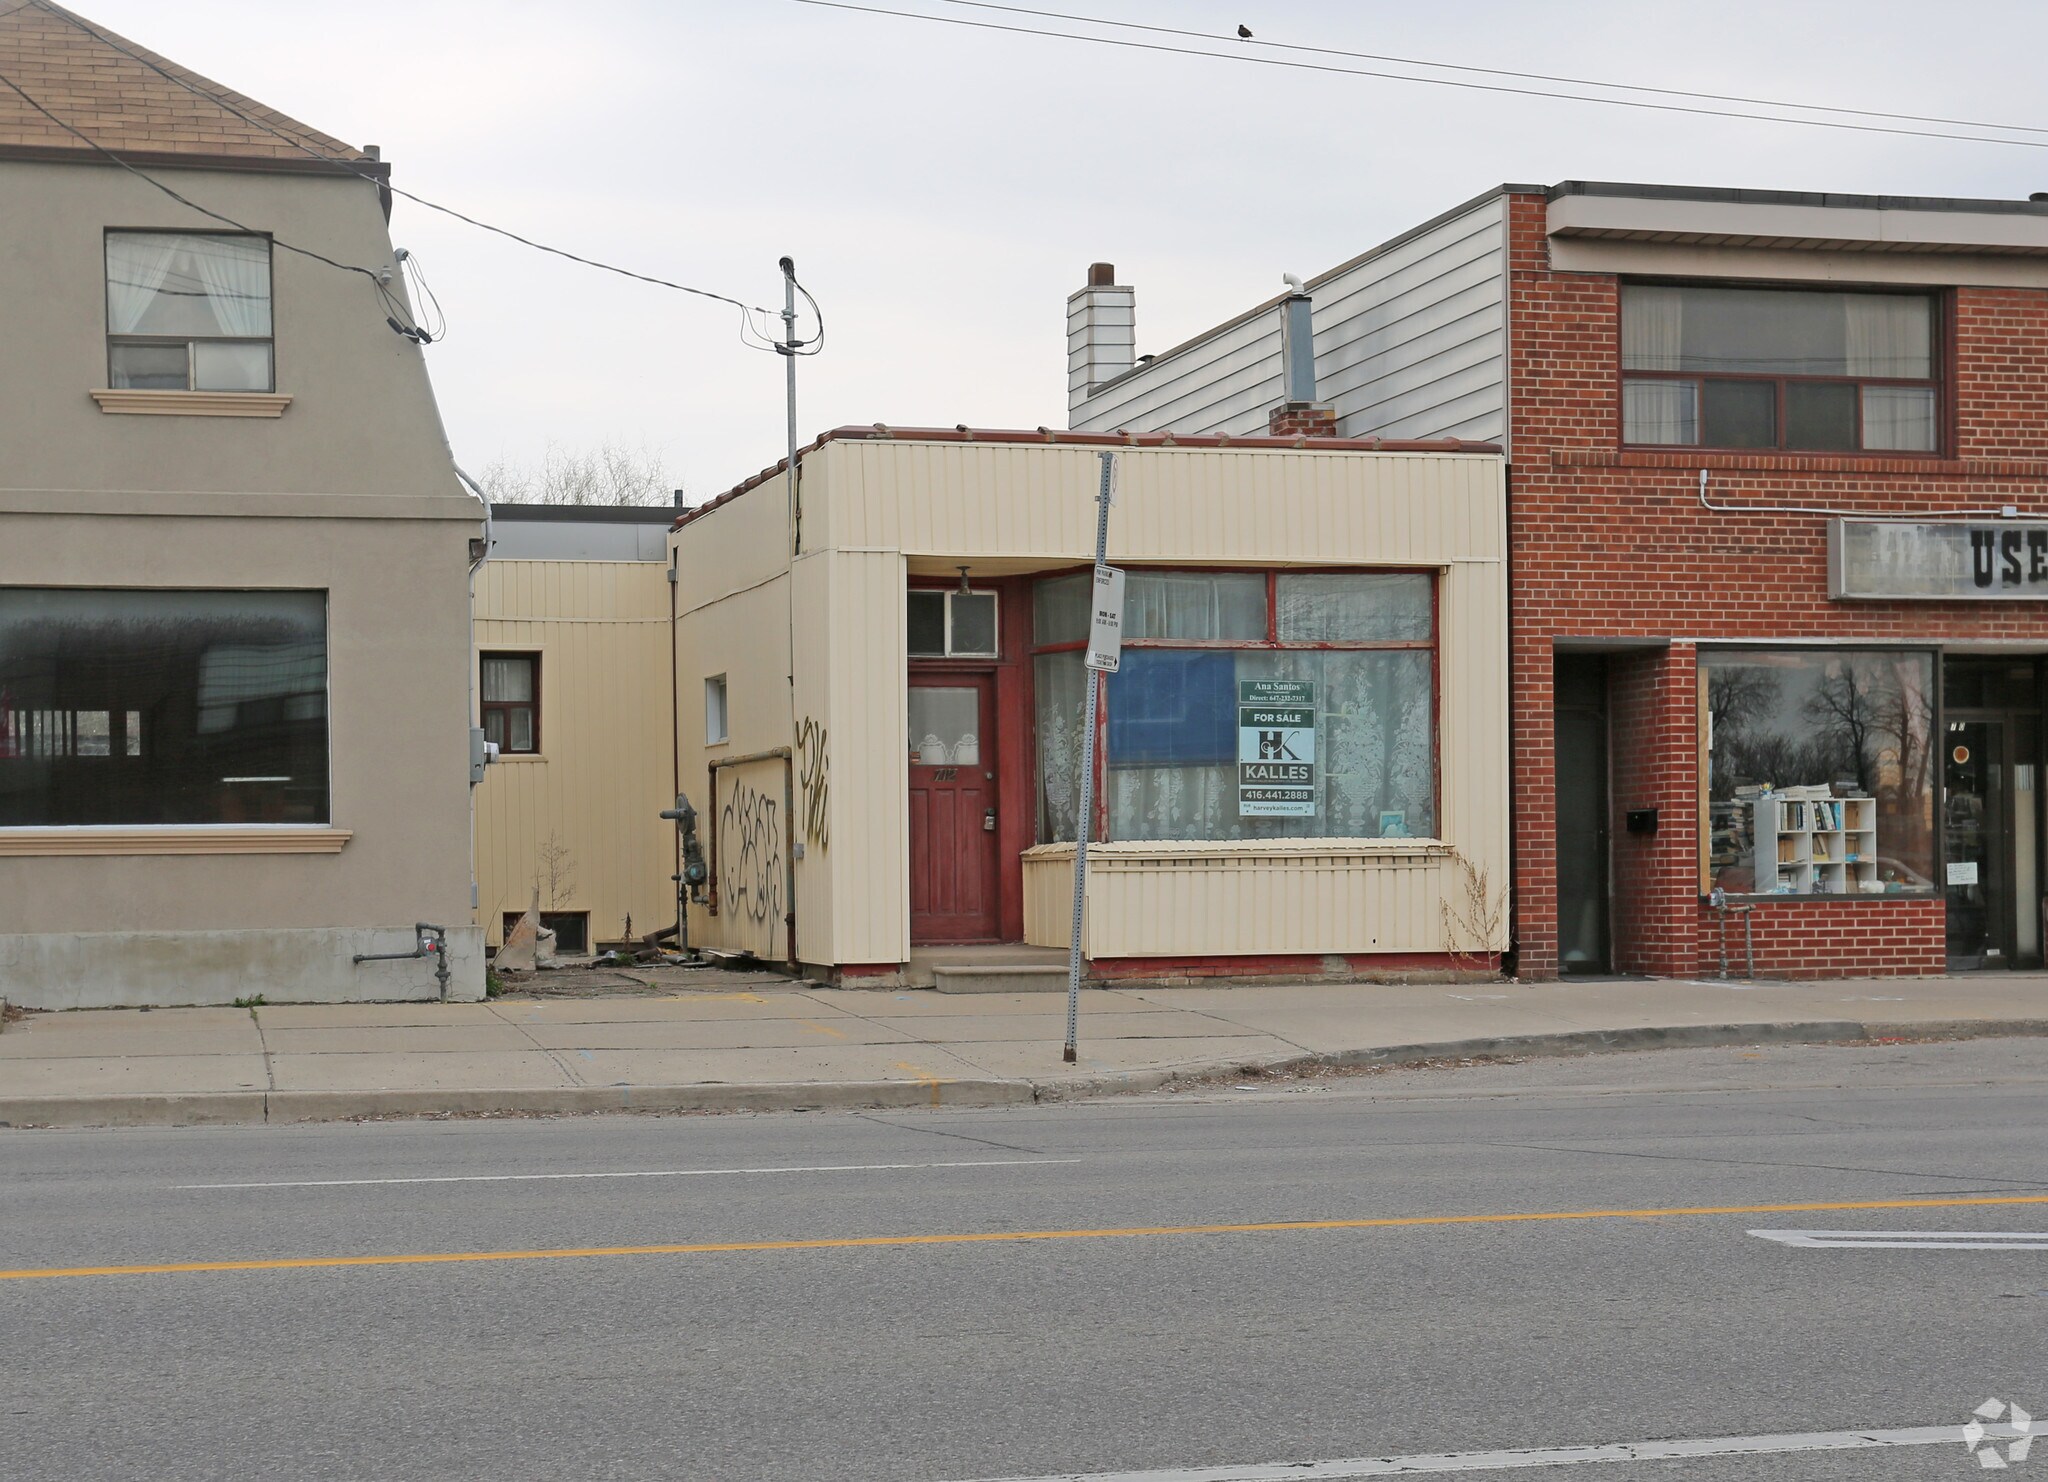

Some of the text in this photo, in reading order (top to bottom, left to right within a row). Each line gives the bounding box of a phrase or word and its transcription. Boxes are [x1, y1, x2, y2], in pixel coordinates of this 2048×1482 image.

[1971, 530, 2048, 588] USE
[1254, 682, 1301, 691] Ana Santos
[1254, 713, 1302, 723] FOR SALE
[1246, 765, 1309, 780] KALLES
[1246, 790, 1308, 800] 416.441.2888
